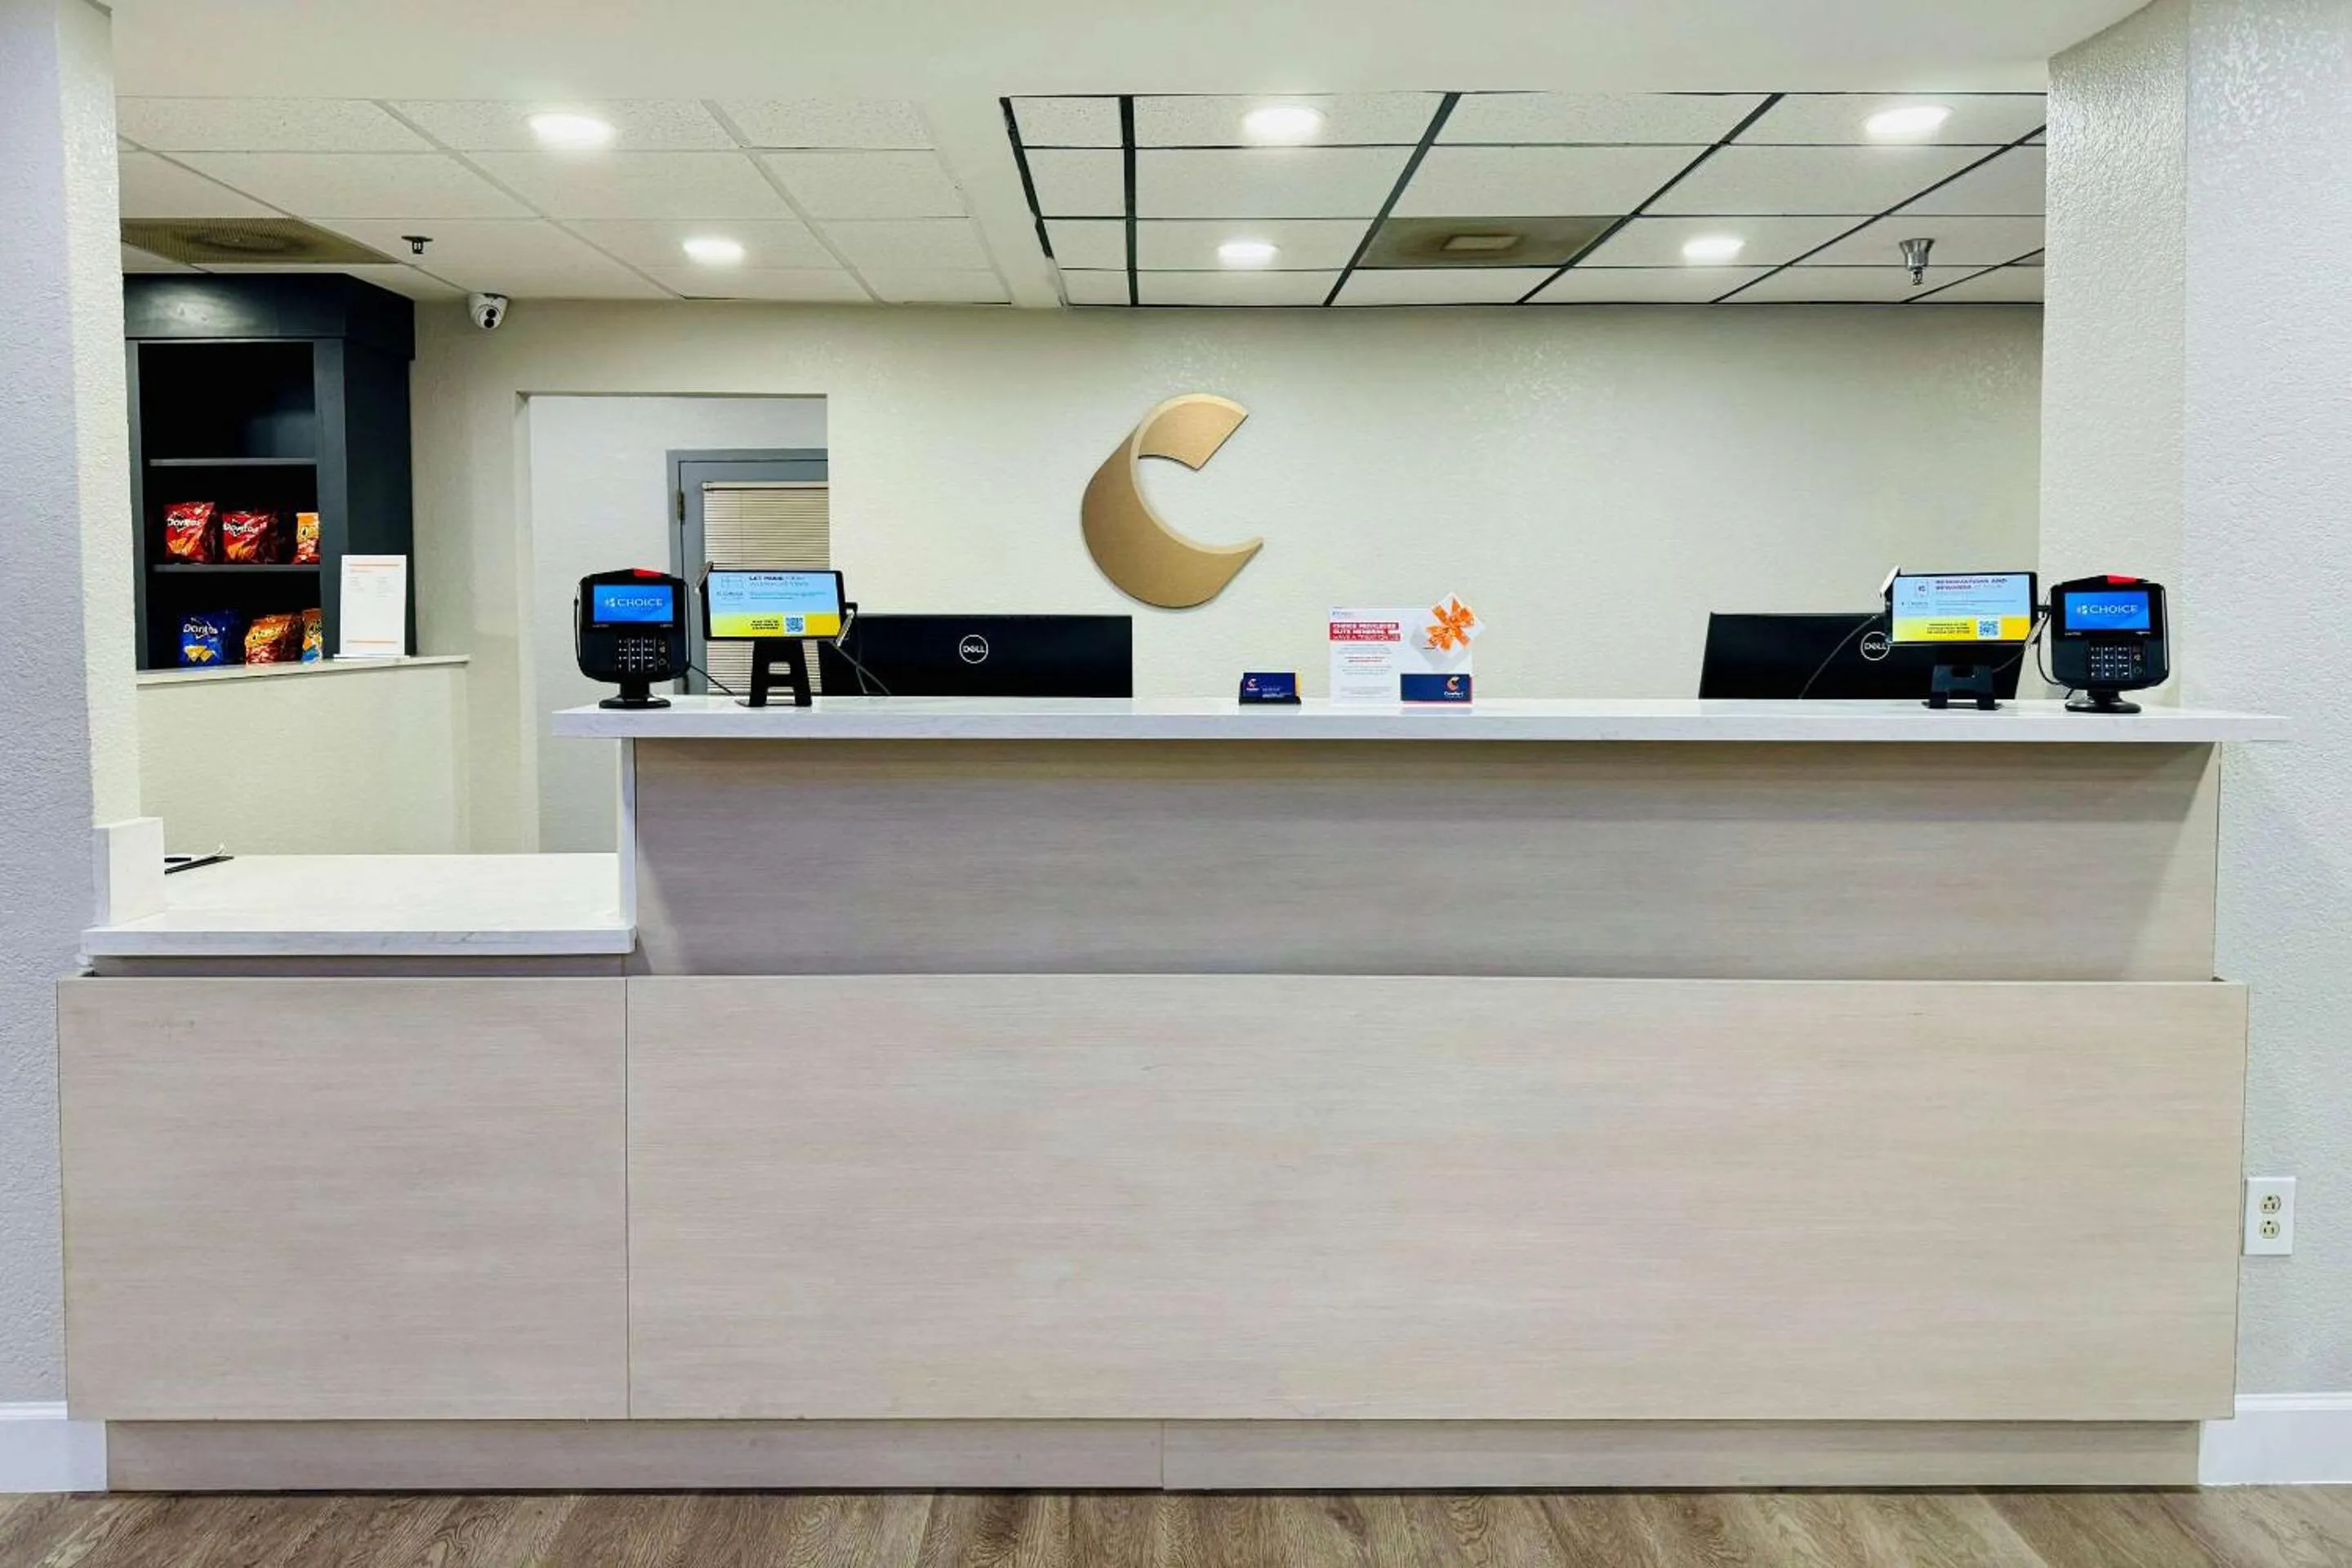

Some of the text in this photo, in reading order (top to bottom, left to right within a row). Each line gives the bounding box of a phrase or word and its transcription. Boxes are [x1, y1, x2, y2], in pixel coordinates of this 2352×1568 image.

[617, 598, 663, 607] CHOICE
[2090, 604, 2139, 614] CHOICE
[183, 623, 218, 634] Doritos
[963, 644, 986, 653] DELL
[1864, 641, 1887, 650] DELL
